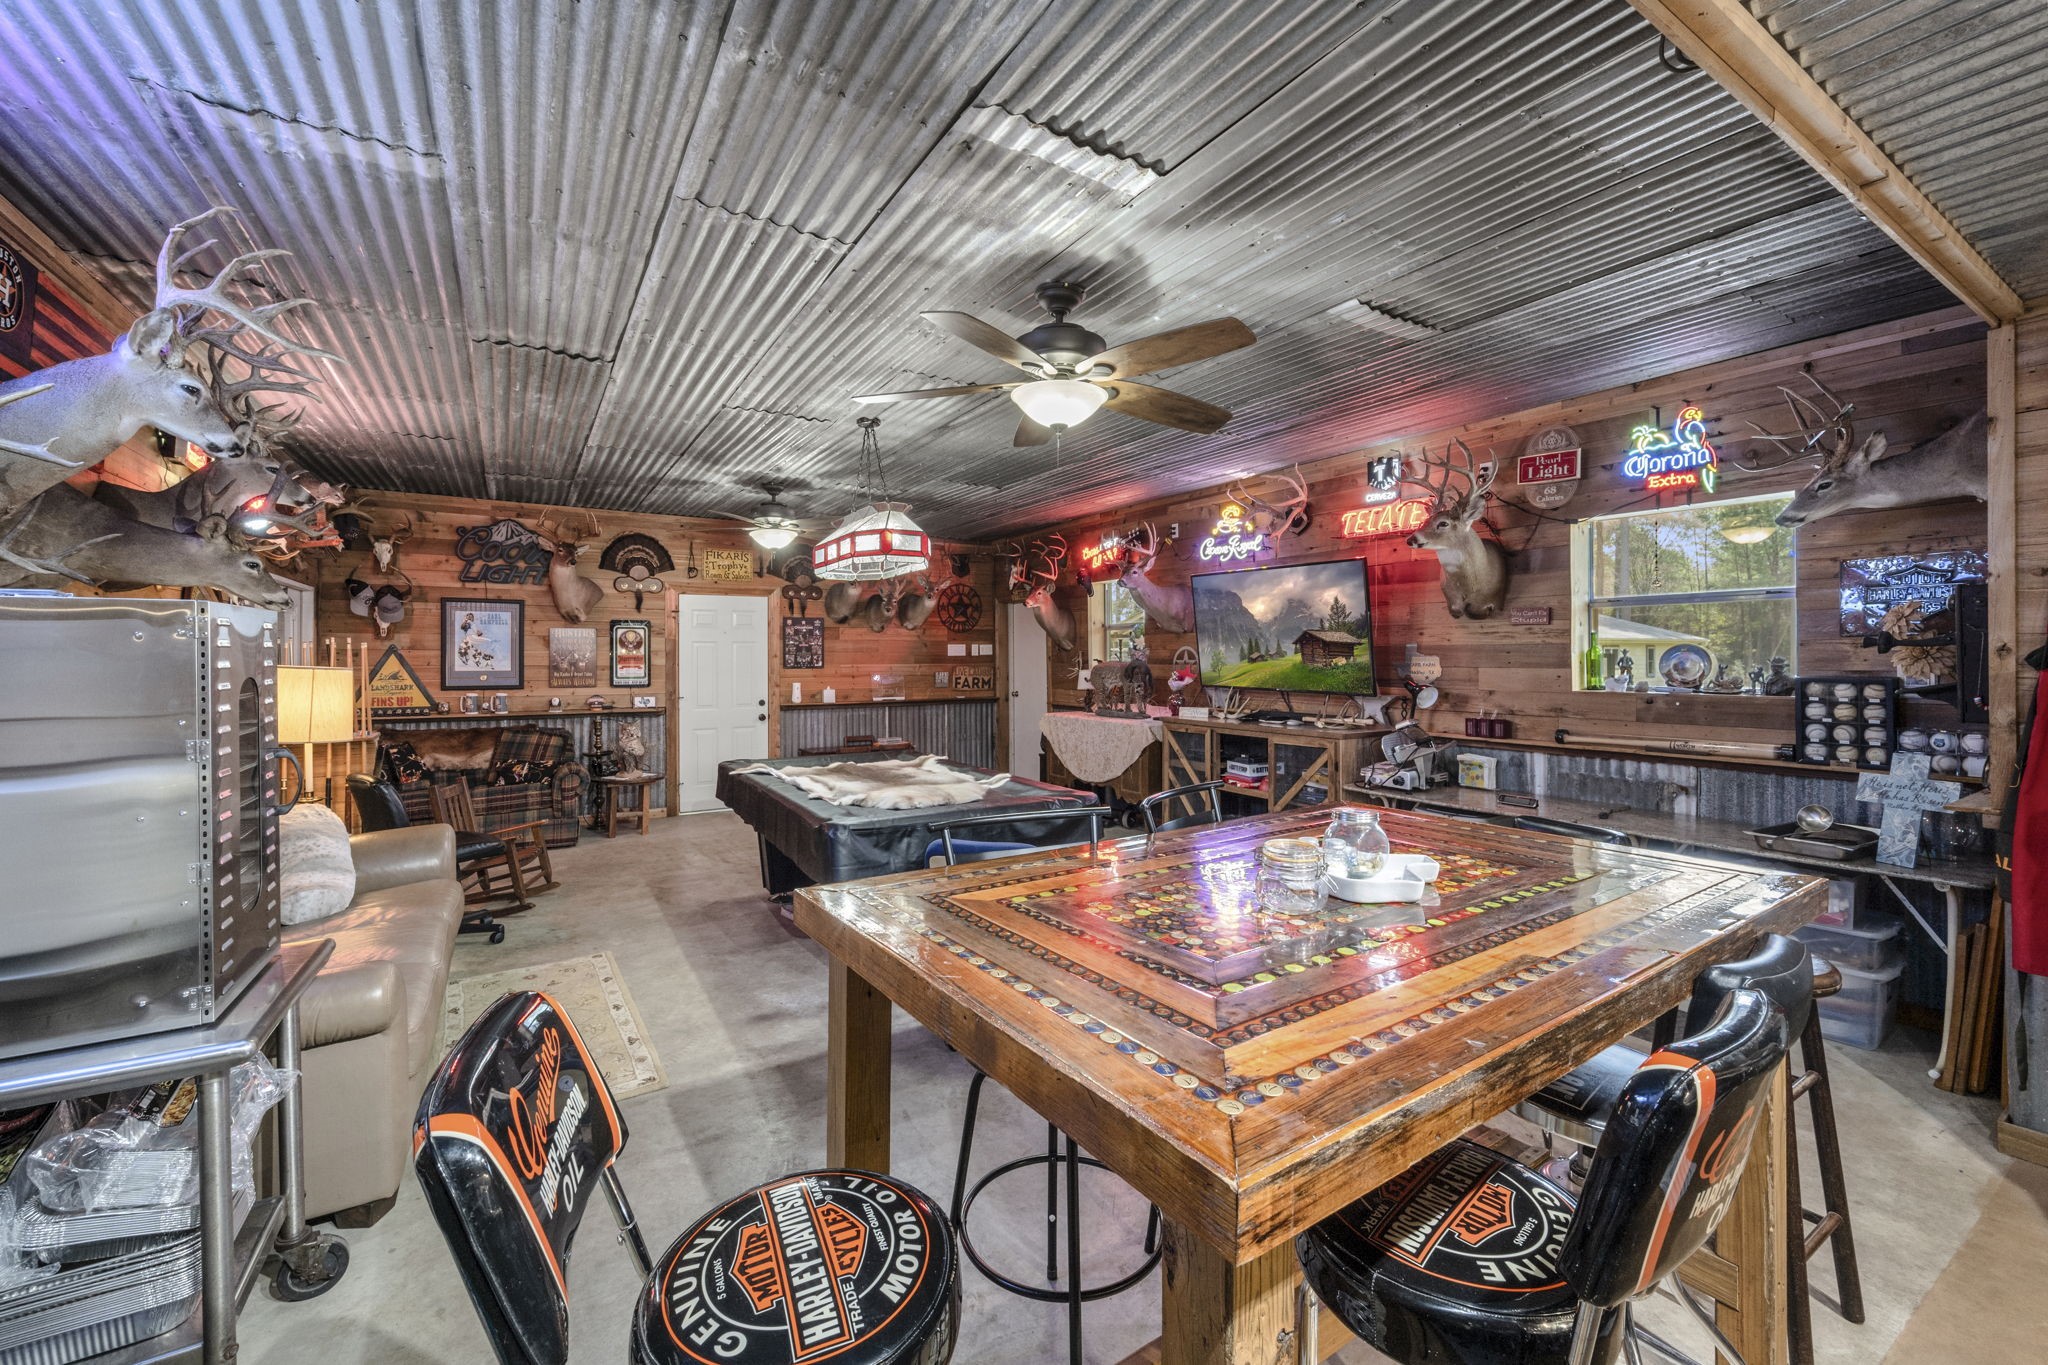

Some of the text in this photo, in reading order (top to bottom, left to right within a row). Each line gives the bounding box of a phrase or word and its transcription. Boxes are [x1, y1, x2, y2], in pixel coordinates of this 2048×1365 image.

[1527, 462, 1570, 479] Light
[1535, 452, 1562, 466] Pearl
[1624, 447, 1711, 479] Corona
[1543, 485, 1558, 496] 68
[1647, 472, 1697, 489] Extra
[1365, 490, 1398, 504] CERVEZA
[1536, 493, 1565, 503] Calories
[1341, 501, 1423, 536] TECATE
[455, 525, 555, 572] Coors
[705, 550, 750, 563] FIKARIS
[1200, 534, 1264, 562] Crown Royal
[458, 558, 547, 586] LIGHT
[705, 570, 750, 580] Room & Saloon
[709, 561, 744, 571] Trophy
[1511, 608, 1522, 617] You
[371, 684, 415, 692] LANDSHARK
[954, 676, 992, 689] FARM
[371, 696, 414, 707] FINS UP!
[507, 1026, 561, 1180] Genuine
[539, 1083, 587, 1220] HARLEY-DAVIDSON
[562, 1152, 585, 1213] OIL
[808, 1176, 825, 1201] MARK
[844, 1176, 897, 1204] OIL
[1383, 1149, 1495, 1255] HARLEY-DAVIDSON
[1454, 1183, 1510, 1236] MOTOR
[862, 1203, 890, 1252] FINEST QUALITY
[1360, 1203, 1390, 1232] MARK
[821, 1206, 861, 1272] CYCLES
[1513, 1222, 1538, 1247] GALLONS
[738, 1227, 781, 1302] MOTOR
[769, 1182, 841, 1346] HARLEY-DAVIDSON
[879, 1208, 922, 1304] MOTOR
[672, 1216, 748, 1358] GENUINE
[715, 1258, 728, 1301] 5 GALLONS
[842, 1281, 866, 1335] TRADE
